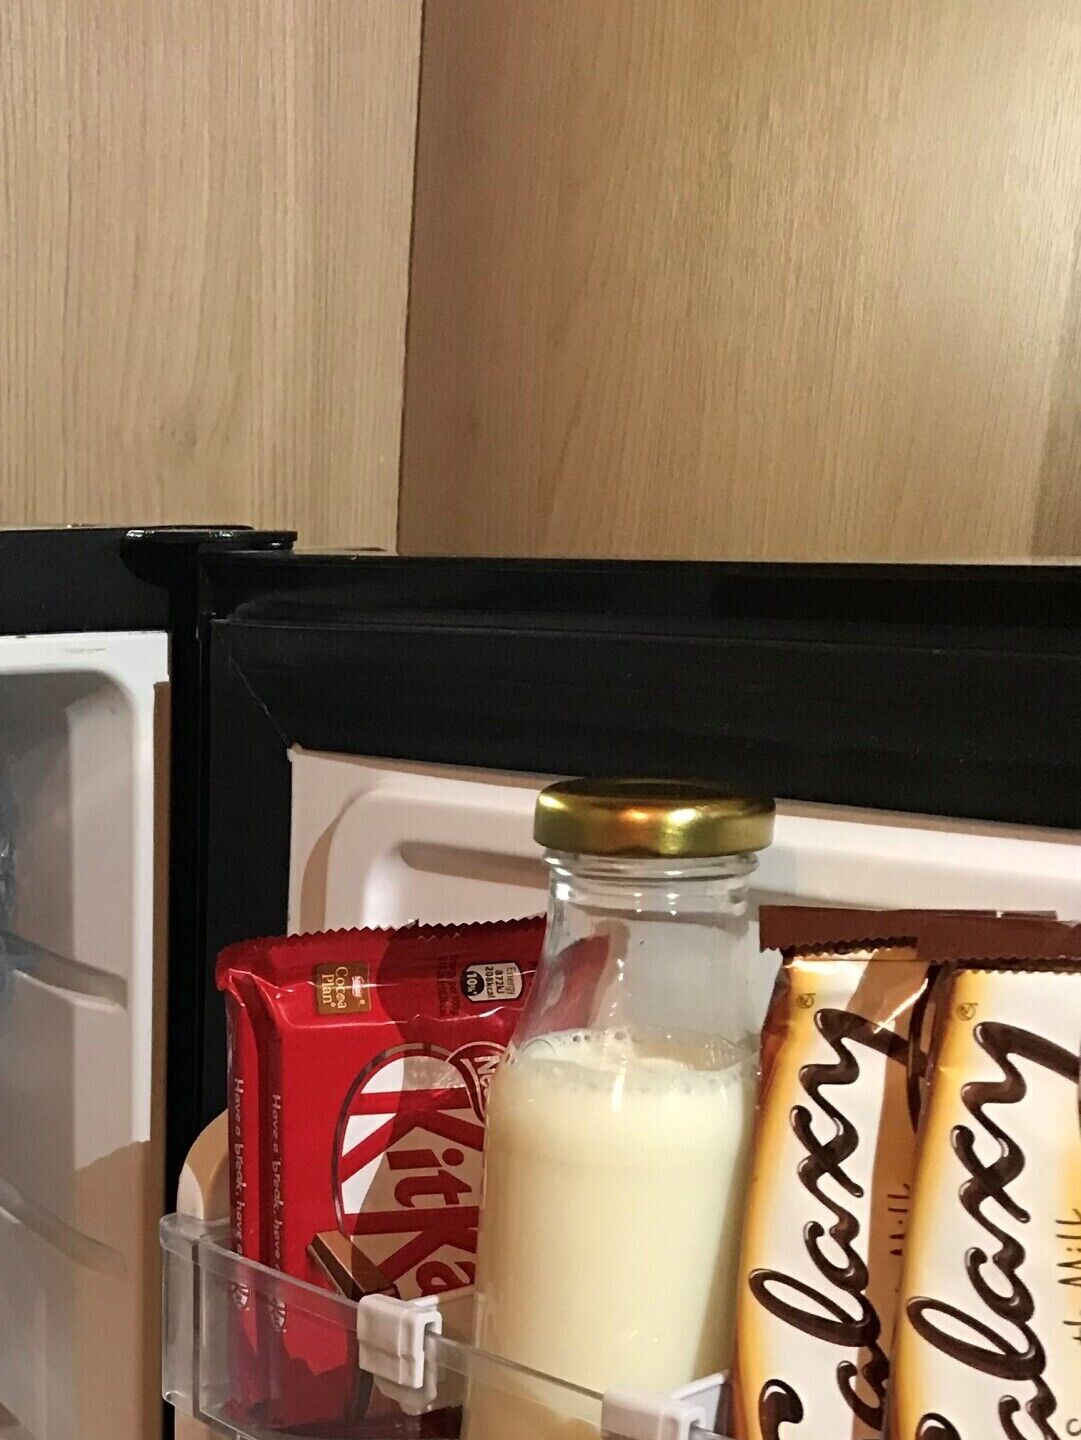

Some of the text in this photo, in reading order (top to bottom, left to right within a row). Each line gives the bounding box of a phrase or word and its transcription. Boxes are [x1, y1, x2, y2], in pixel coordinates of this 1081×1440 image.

[334, 966, 349, 1009] Cocoa
[506, 966, 517, 996] Energy
[234, 1078, 245, 1123] Have
[271, 1094, 282, 1139] Have
[235, 1200, 245, 1241] have
[273, 1218, 283, 1259] have
